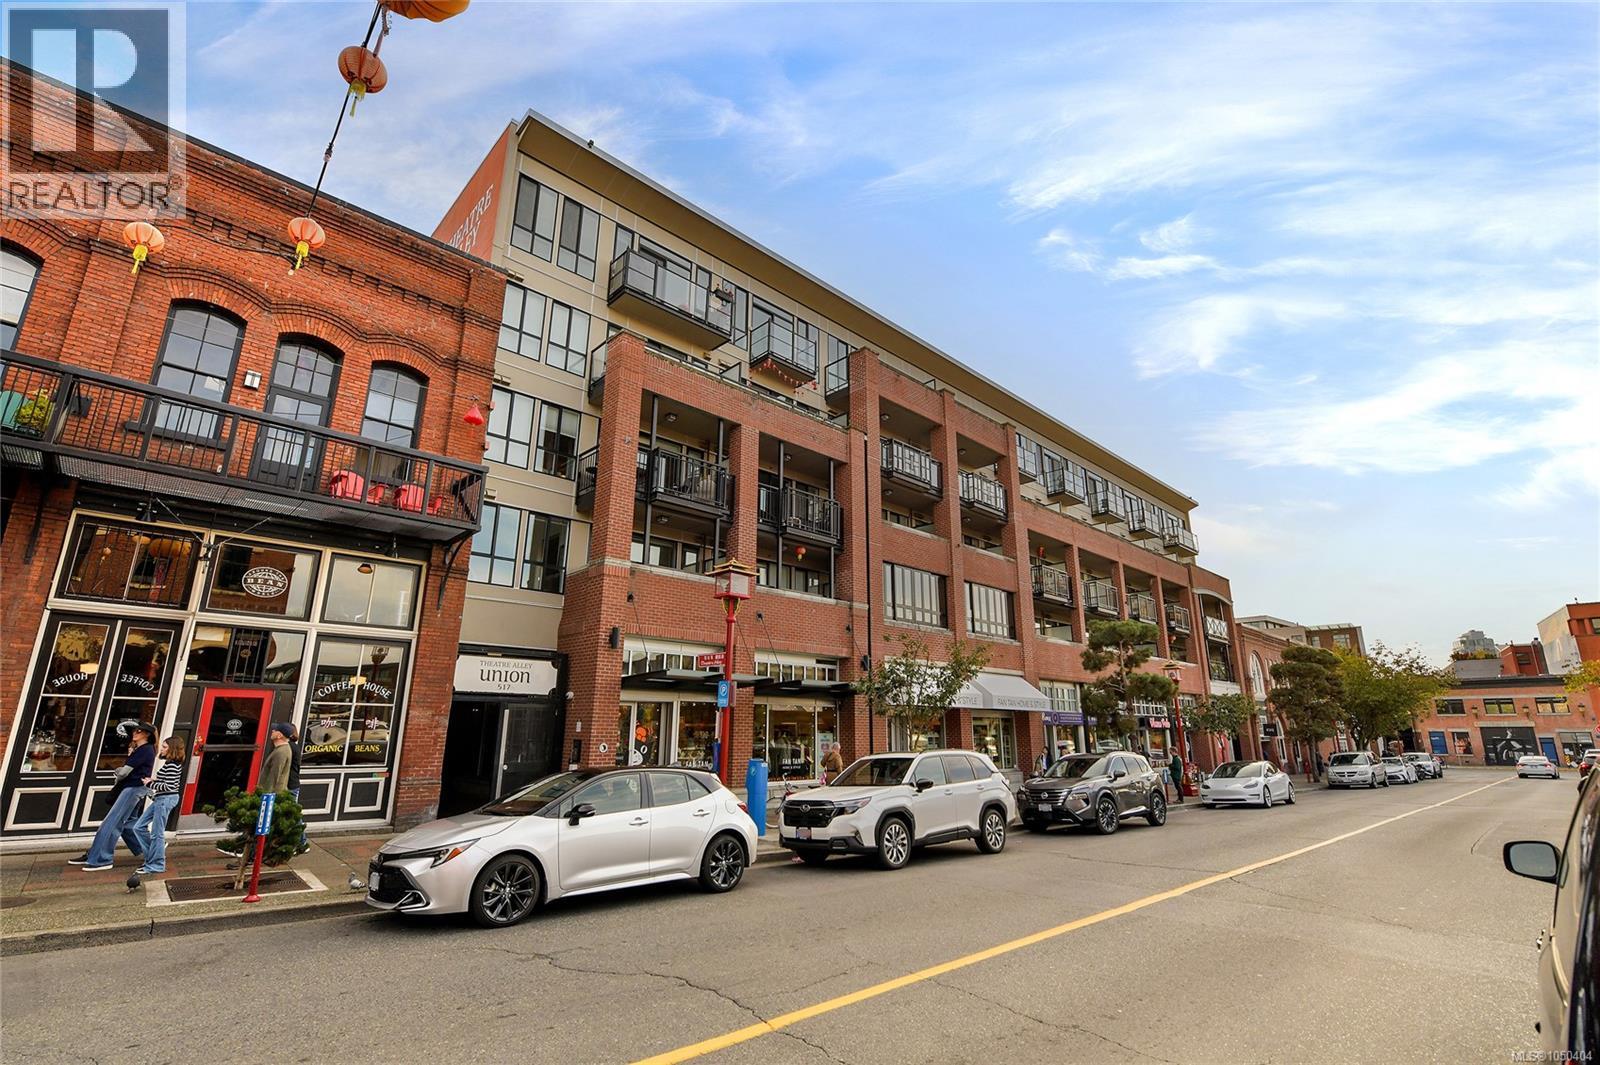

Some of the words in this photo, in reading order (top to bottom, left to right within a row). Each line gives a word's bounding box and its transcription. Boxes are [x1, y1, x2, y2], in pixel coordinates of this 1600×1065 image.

[480, 660, 511, 669] THEATRE
[480, 668, 530, 683] union
[318, 680, 354, 698] COFFEE
[363, 682, 392, 699] HOUSE
[305, 744, 344, 753] ORGANIC
[354, 744, 381, 752] BEANS
